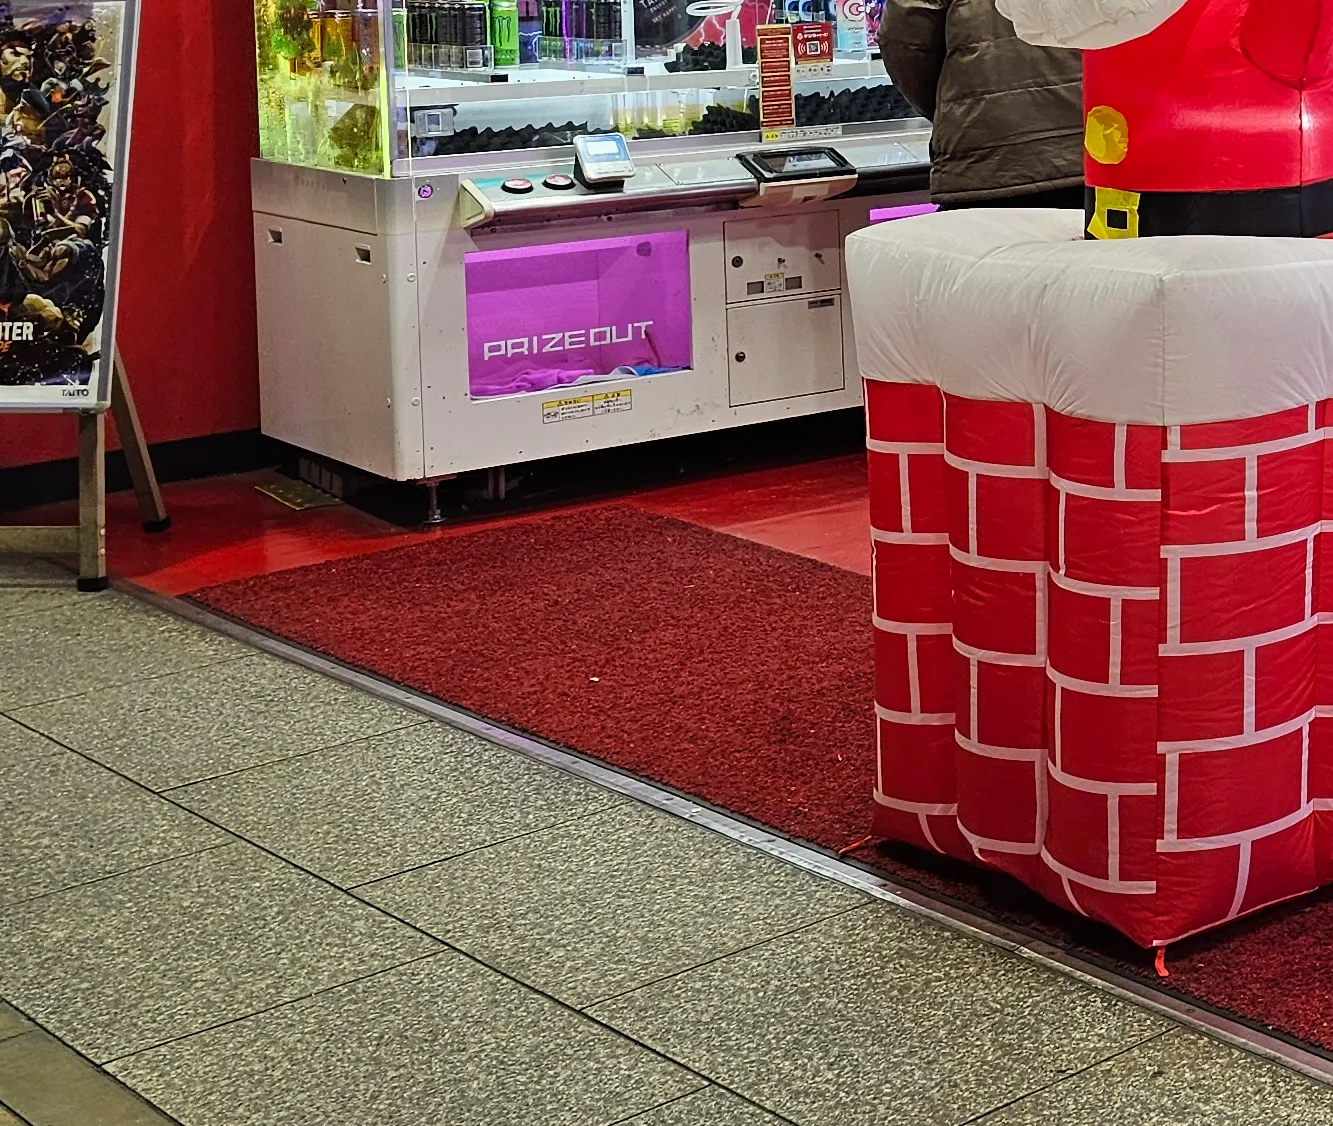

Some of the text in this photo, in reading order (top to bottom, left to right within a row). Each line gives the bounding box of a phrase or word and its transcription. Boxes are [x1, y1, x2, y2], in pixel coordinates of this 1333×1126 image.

[483, 320, 654, 361] PRIZE OUT
[61, 388, 90, 398] TAITO
